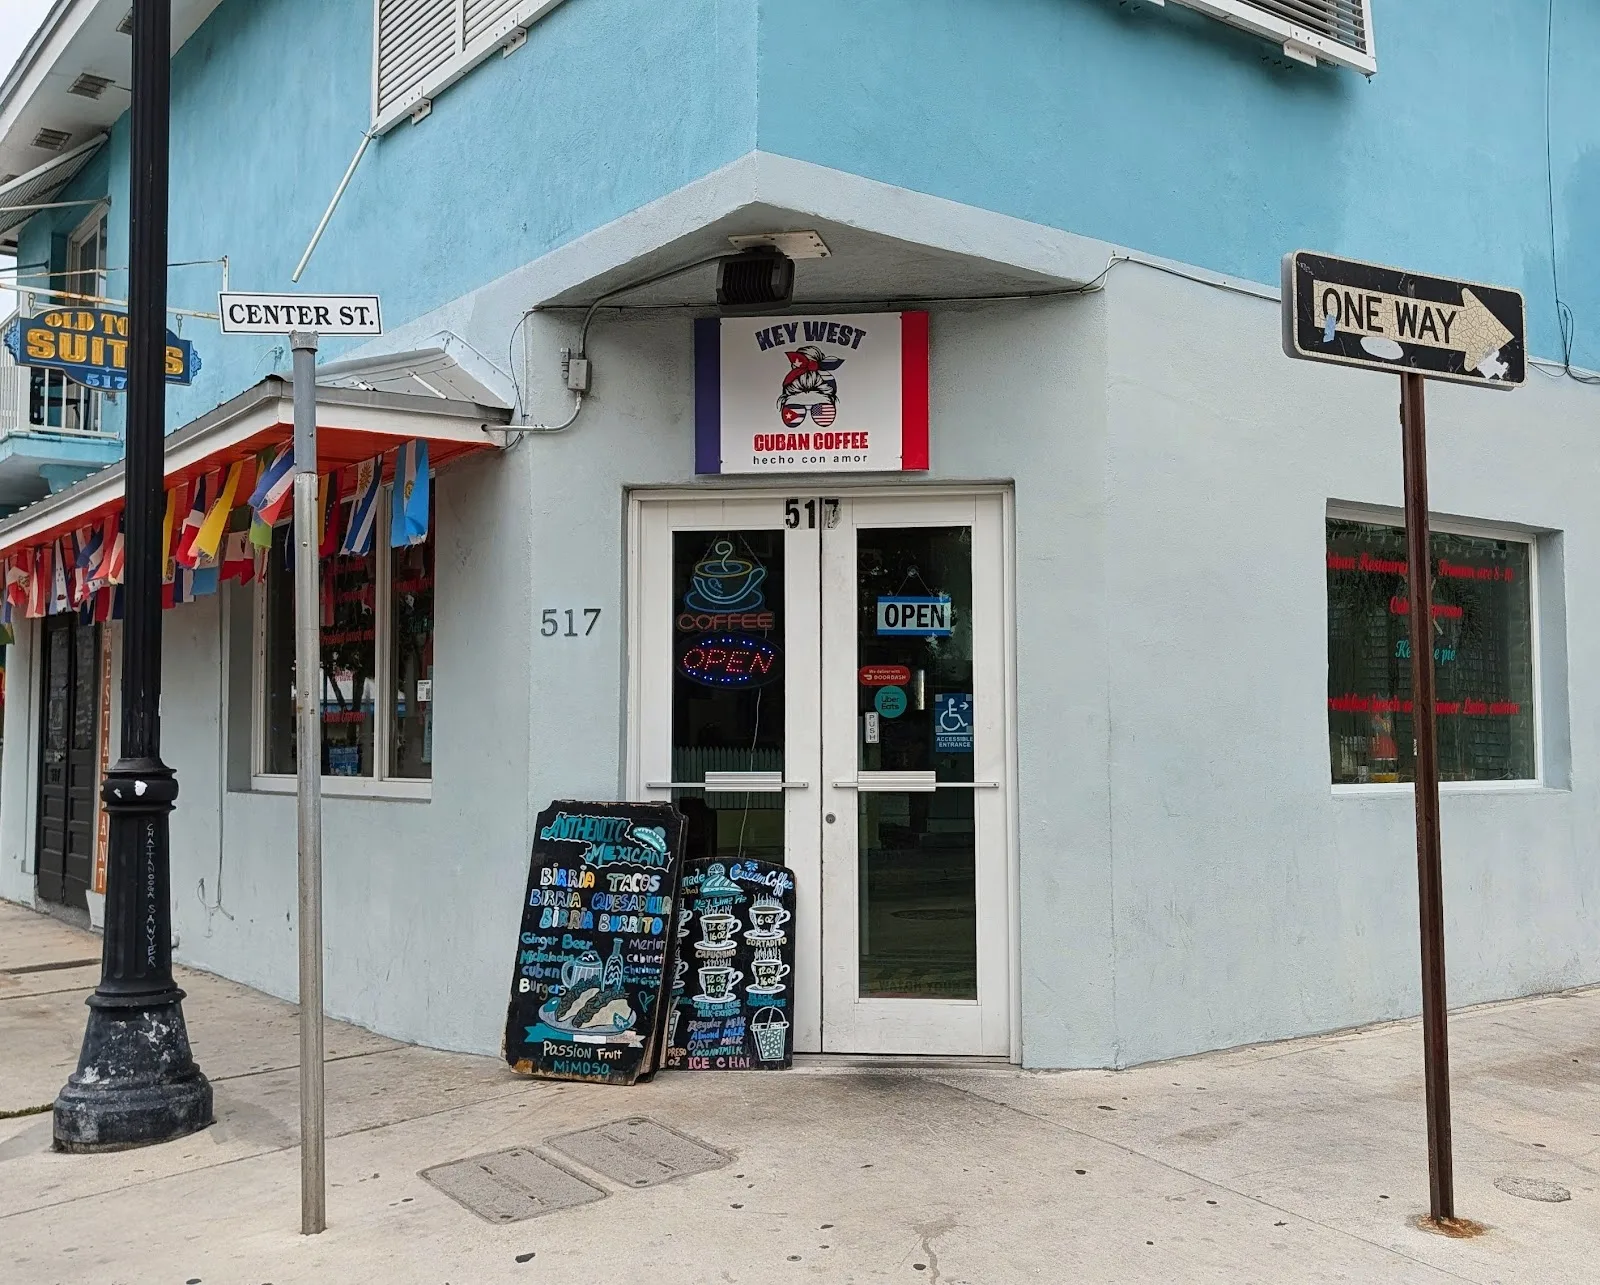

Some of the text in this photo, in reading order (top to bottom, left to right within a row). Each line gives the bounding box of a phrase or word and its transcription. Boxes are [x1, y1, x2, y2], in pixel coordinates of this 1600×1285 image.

[44, 311, 129, 337] OLD TO
[229, 304, 374, 326] CENTER ST.
[1321, 287, 1457, 345] ONE WAY
[755, 321, 867, 351] KEY WEST
[26, 328, 184, 376] SUITS
[85, 372, 128, 390] 517
[754, 432, 869, 452] CUBAN COFFEE
[753, 454, 868, 465] hecho con amor
[784, 498, 840, 530] 517
[540, 608, 602, 637] 517
[679, 612, 773, 631] COFFEE
[885, 603, 945, 628] OPEN
[1395, 639, 1411, 658] Ke
[684, 648, 774, 675] OPEN
[99, 638, 112, 889] RESTAANT
[587, 842, 665, 866] MEXICAN
[606, 872, 661, 893] TACOS
[765, 870, 794, 897] Coffee
[758, 914, 764, 925] 6
[521, 932, 593, 951] Ginger Beer
[628, 938, 666, 951] Merlot
[746, 937, 788, 947] CORTADITO
[518, 978, 567, 1000] Burgers
[706, 975, 715, 984] 12
[707, 985, 715, 994] 16
[687, 1039, 713, 1051] OAT
[687, 1056, 711, 1069] ICE
